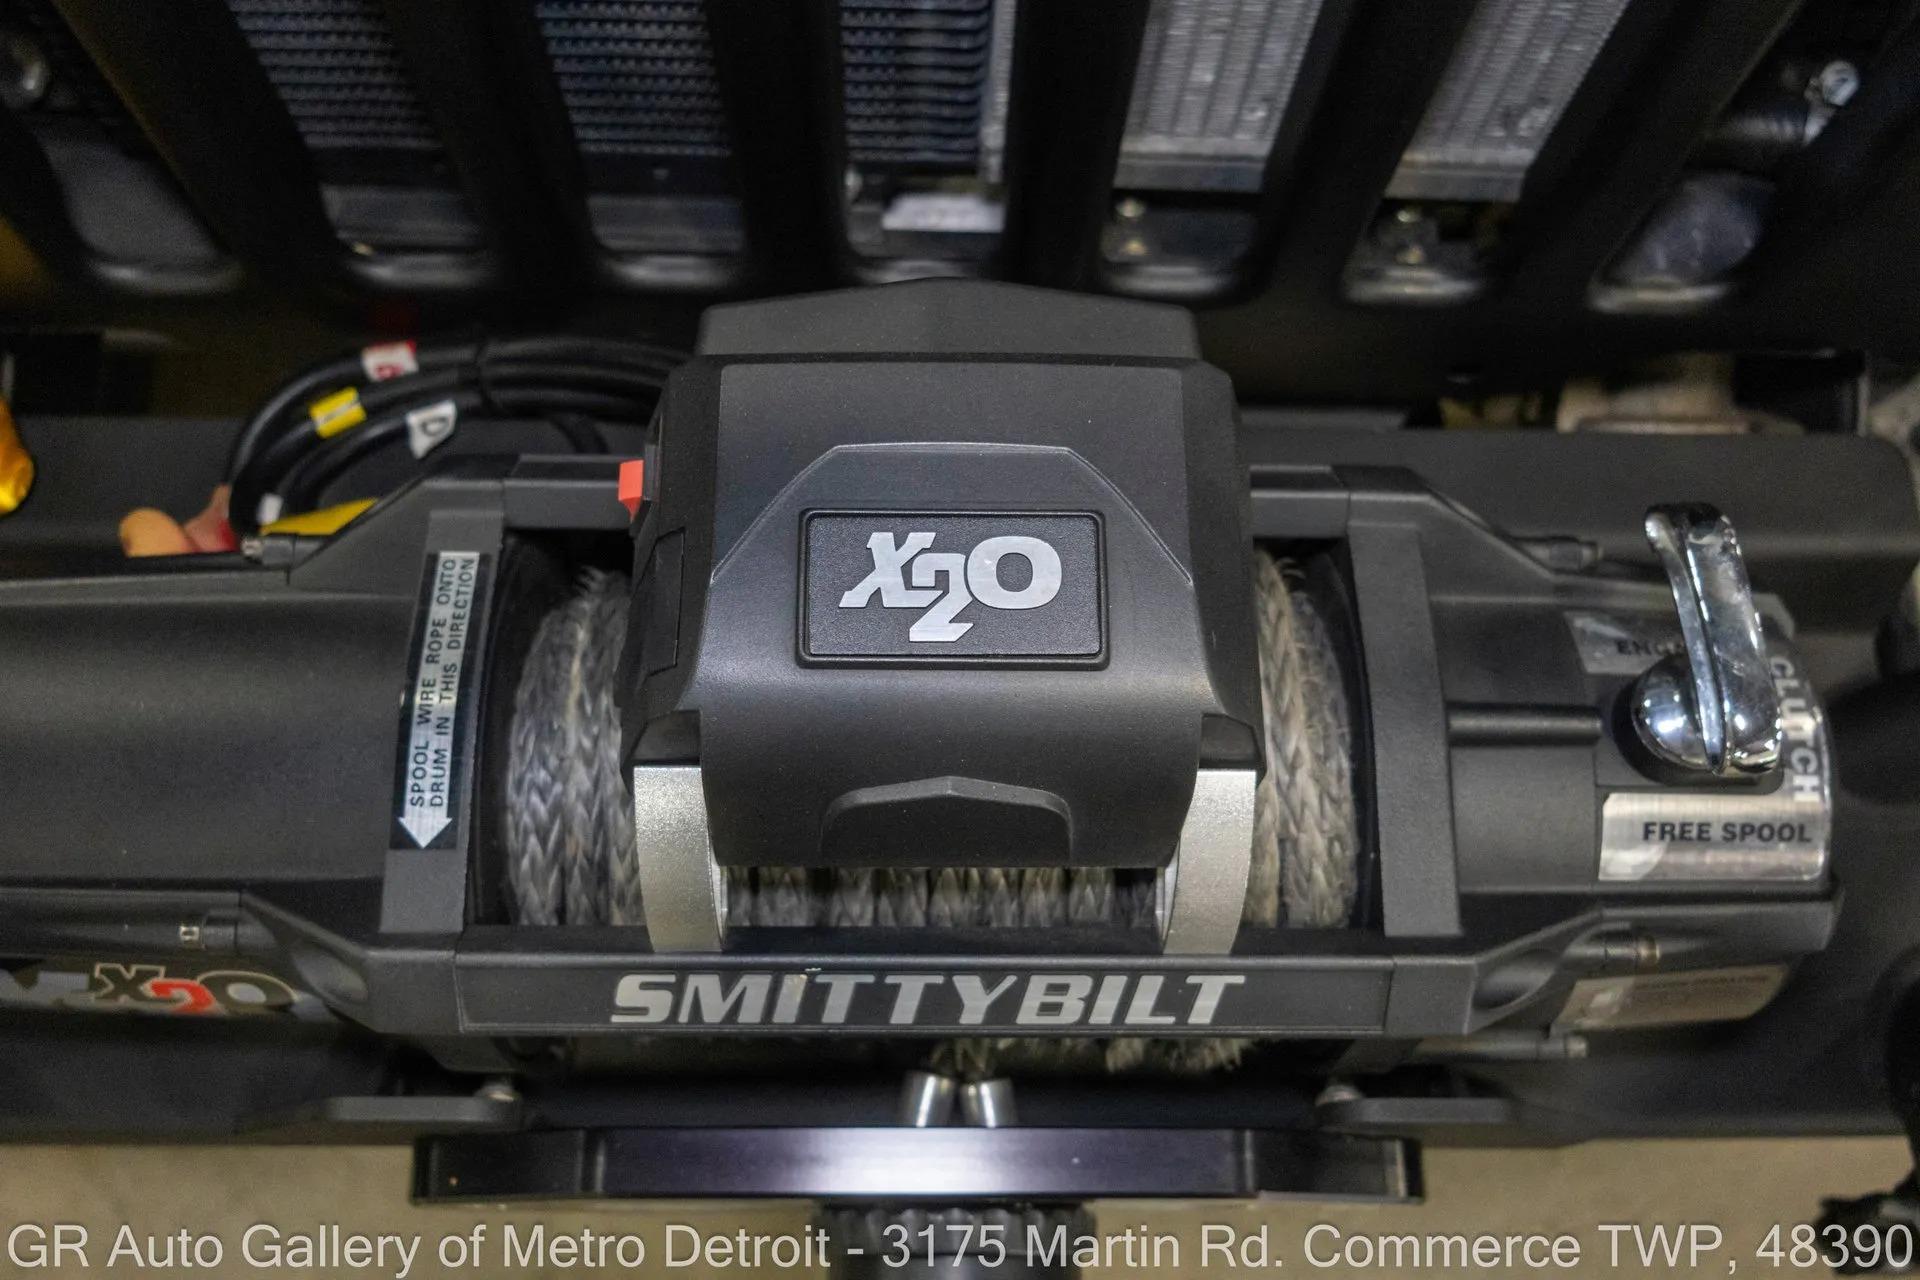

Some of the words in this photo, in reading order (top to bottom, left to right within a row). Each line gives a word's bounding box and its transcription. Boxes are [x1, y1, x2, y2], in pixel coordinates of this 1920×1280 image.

[436, 559, 457, 606] ONTO
[447, 558, 475, 650] DIRECTION
[425, 618, 447, 665] ROPE
[417, 678, 436, 726] WIRE
[439, 662, 458, 704] THIS
[435, 716, 451, 736] IN
[410, 740, 430, 808] SPOOL
[430, 748, 448, 807] DRUM
[1642, 821, 1712, 842] FREE
[1720, 821, 1813, 843] SPOOL
[610, 973, 1246, 1025] SMITTYBILT
